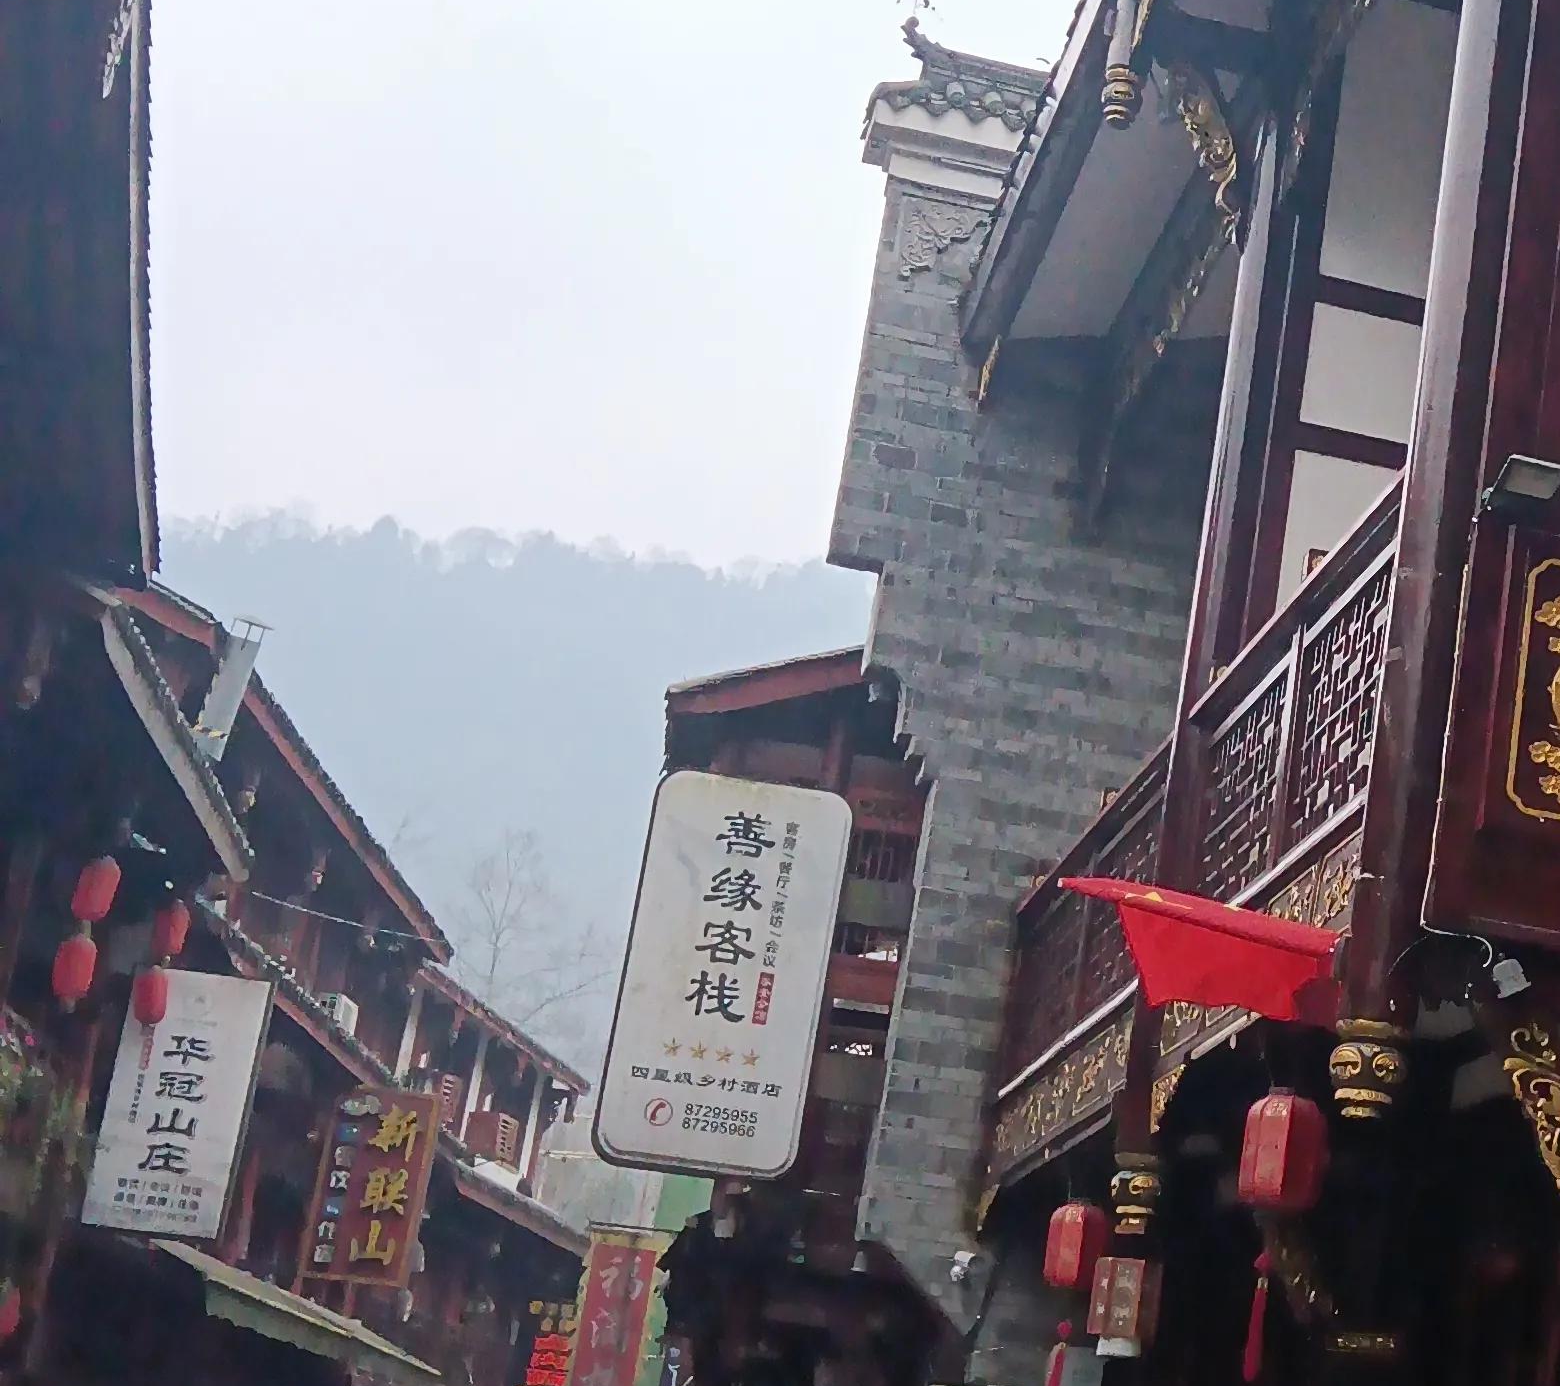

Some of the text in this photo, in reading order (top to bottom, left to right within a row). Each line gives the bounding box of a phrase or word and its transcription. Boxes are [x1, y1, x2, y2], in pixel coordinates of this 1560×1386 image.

[684, 810, 777, 1025] 善缘客栈
[631, 1065, 783, 1098] 四星级乡村酒店
[138, 1034, 216, 1175] 华冠山庄
[684, 1102, 760, 1125] 87295955
[681, 1116, 757, 1139] 87295966
